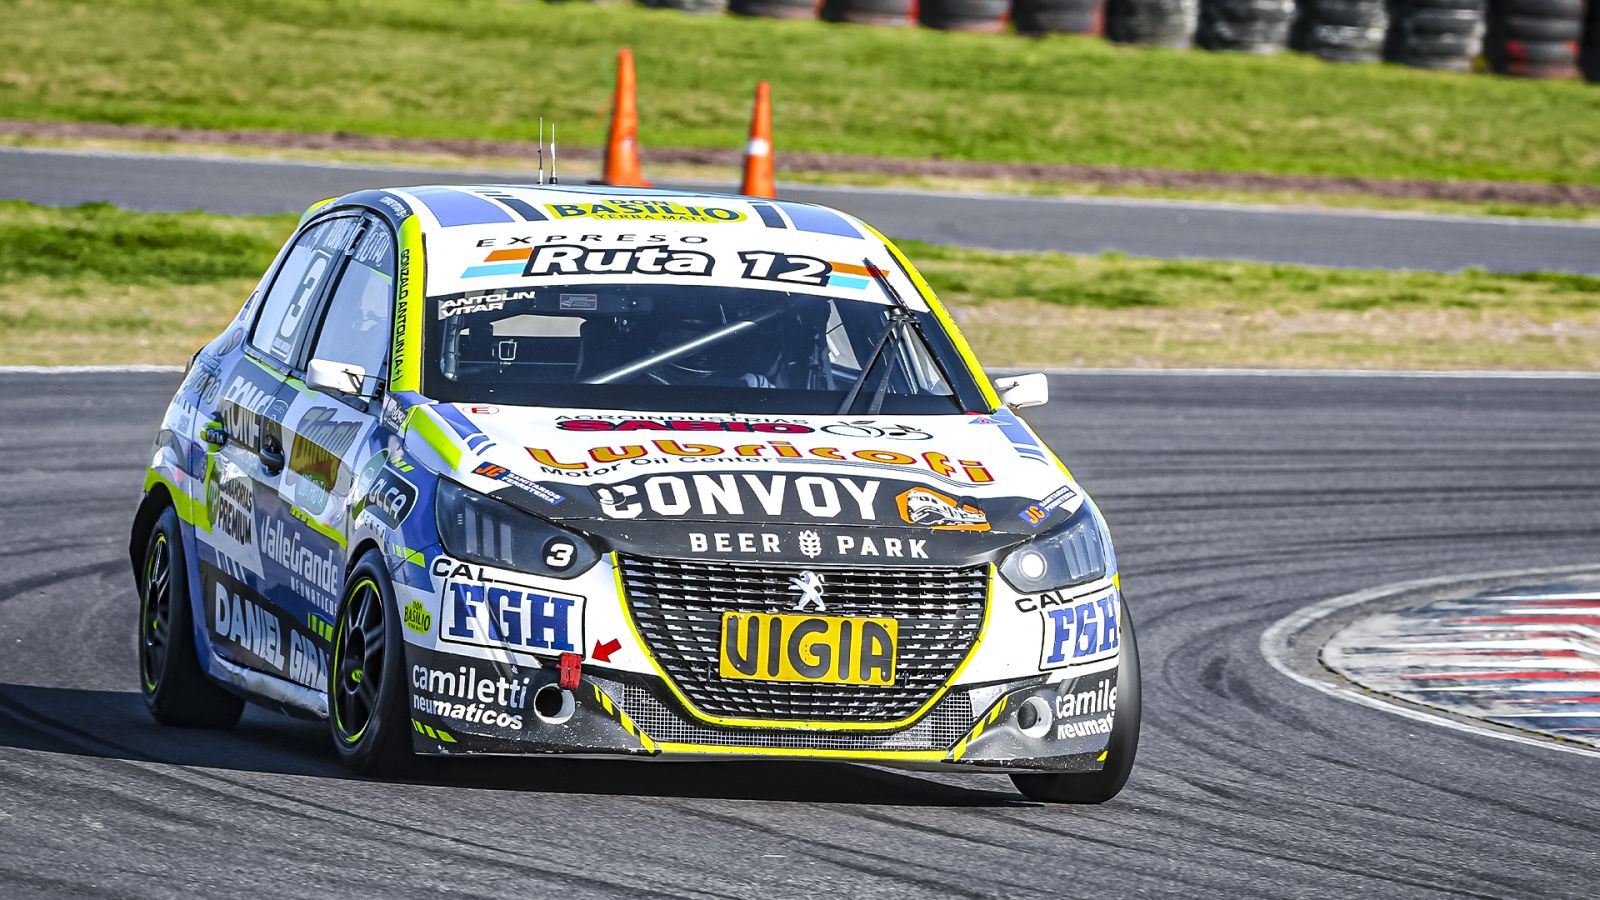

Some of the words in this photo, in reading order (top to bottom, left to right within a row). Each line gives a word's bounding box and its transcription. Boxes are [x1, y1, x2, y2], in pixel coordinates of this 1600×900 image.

[551, 203, 740, 221] BASILIO
[662, 214, 710, 223] MATE
[476, 234, 709, 248] EXPRESO
[399, 248, 410, 300] GONZALO
[523, 244, 716, 277] Ruta
[740, 249, 833, 287] 12
[279, 256, 329, 339] 3
[440, 291, 536, 309] ANTOLIN
[440, 302, 506, 318] VITAR
[396, 301, 408, 354] ANTOLIN
[554, 415, 809, 425] AGROINDUSTRIAS
[555, 419, 816, 434] SABIO
[523, 438, 996, 484] Lubricofi
[539, 464, 622, 479] Motor
[631, 456, 668, 466] Oil
[678, 455, 773, 464] Center
[507, 472, 561, 500] SANITARIOS
[600, 473, 881, 520] CONVOY
[218, 495, 252, 546] PREMIUM
[546, 543, 573, 568] 3
[689, 531, 783, 555] BEER
[836, 534, 930, 560] PARK
[432, 558, 495, 583] CAL
[1014, 591, 1075, 613] CAL
[215, 581, 285, 672] DANIEL
[404, 605, 431, 632] BASILIO
[449, 581, 575, 652] FGH
[412, 664, 530, 709] camiletti
[413, 693, 523, 730] neumaticos
